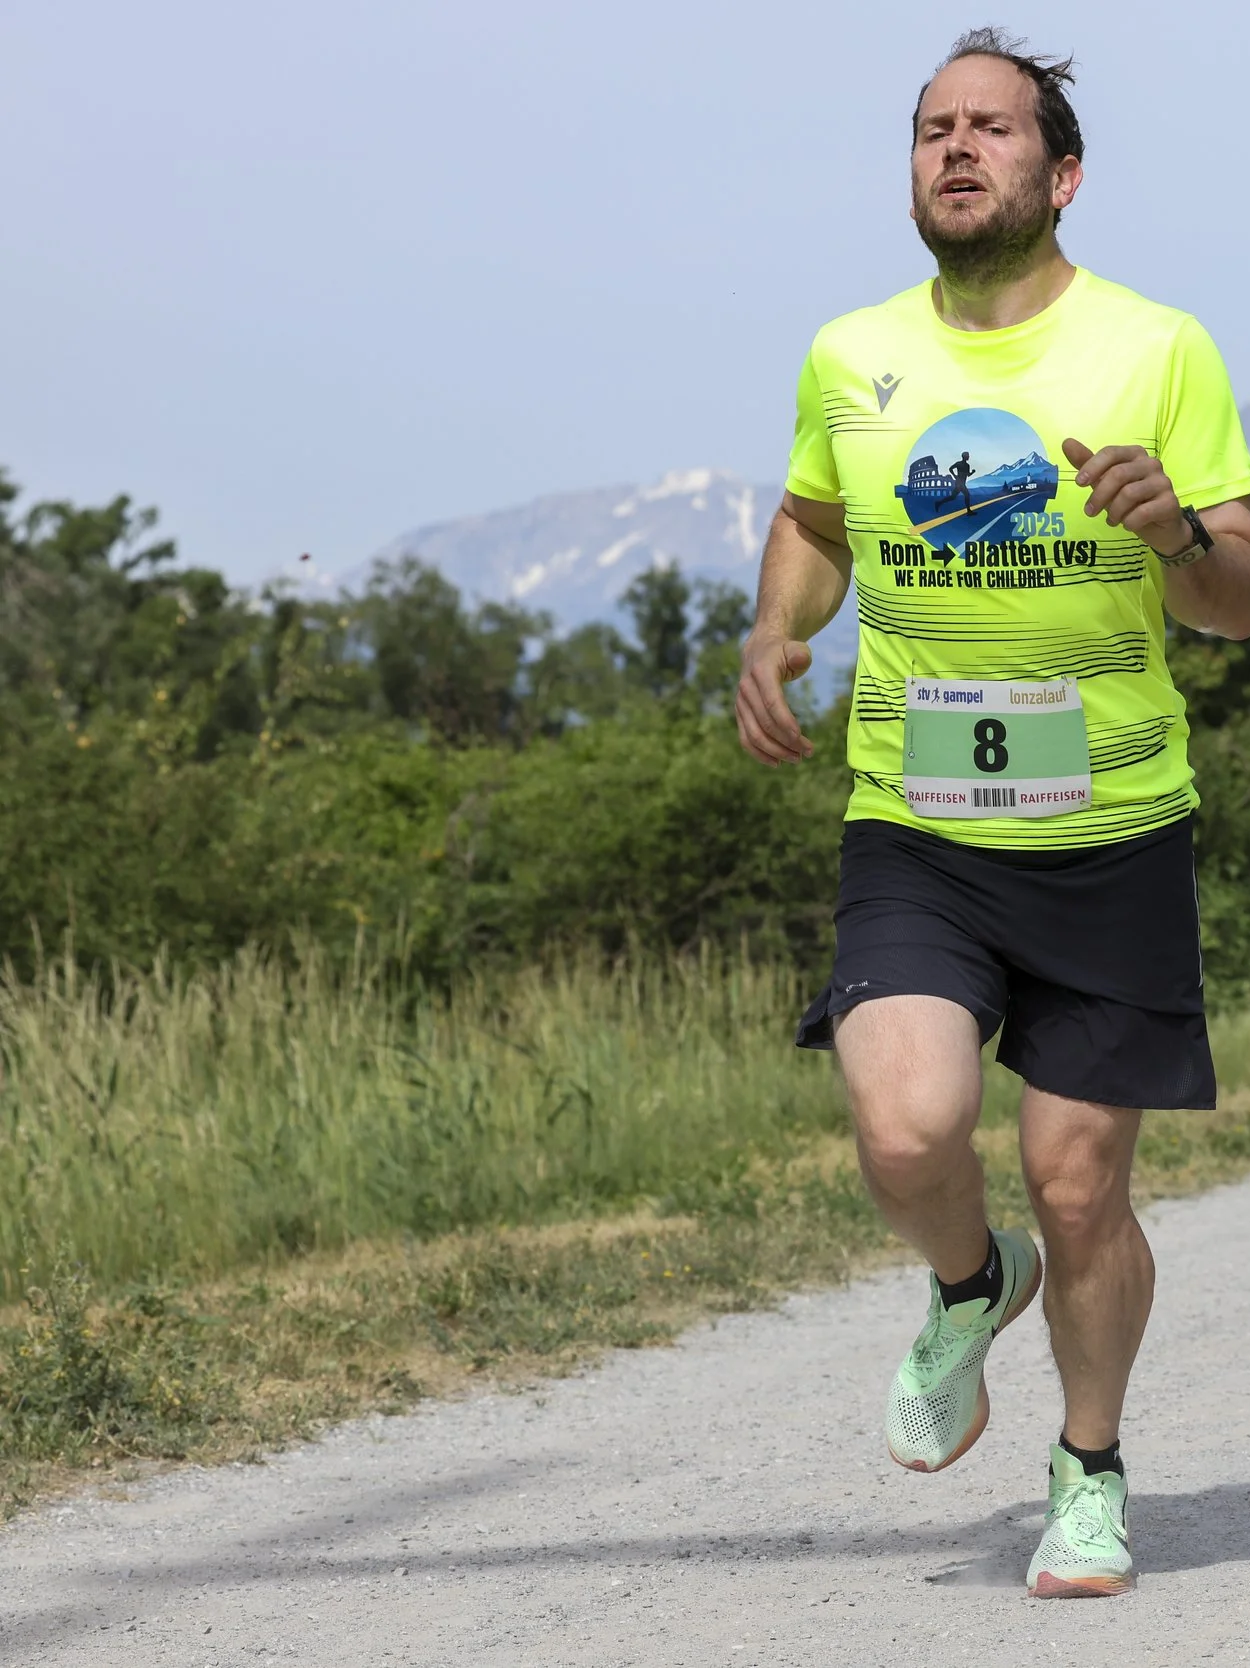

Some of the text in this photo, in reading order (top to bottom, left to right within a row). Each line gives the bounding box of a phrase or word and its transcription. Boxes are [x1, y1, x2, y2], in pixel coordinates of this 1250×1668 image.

[1010, 512, 1065, 537] 2025
[879, 540, 1097, 567] Rom Blatten (VS)
[894, 569, 1055, 588] WE RACE FOR CHILDREN
[918, 688, 983, 704] stv gampel
[1010, 687, 1066, 704] lonzalauf
[973, 718, 1009, 773] 8
[908, 789, 1086, 804] RAIFFEISEN RAIFFEISEN
